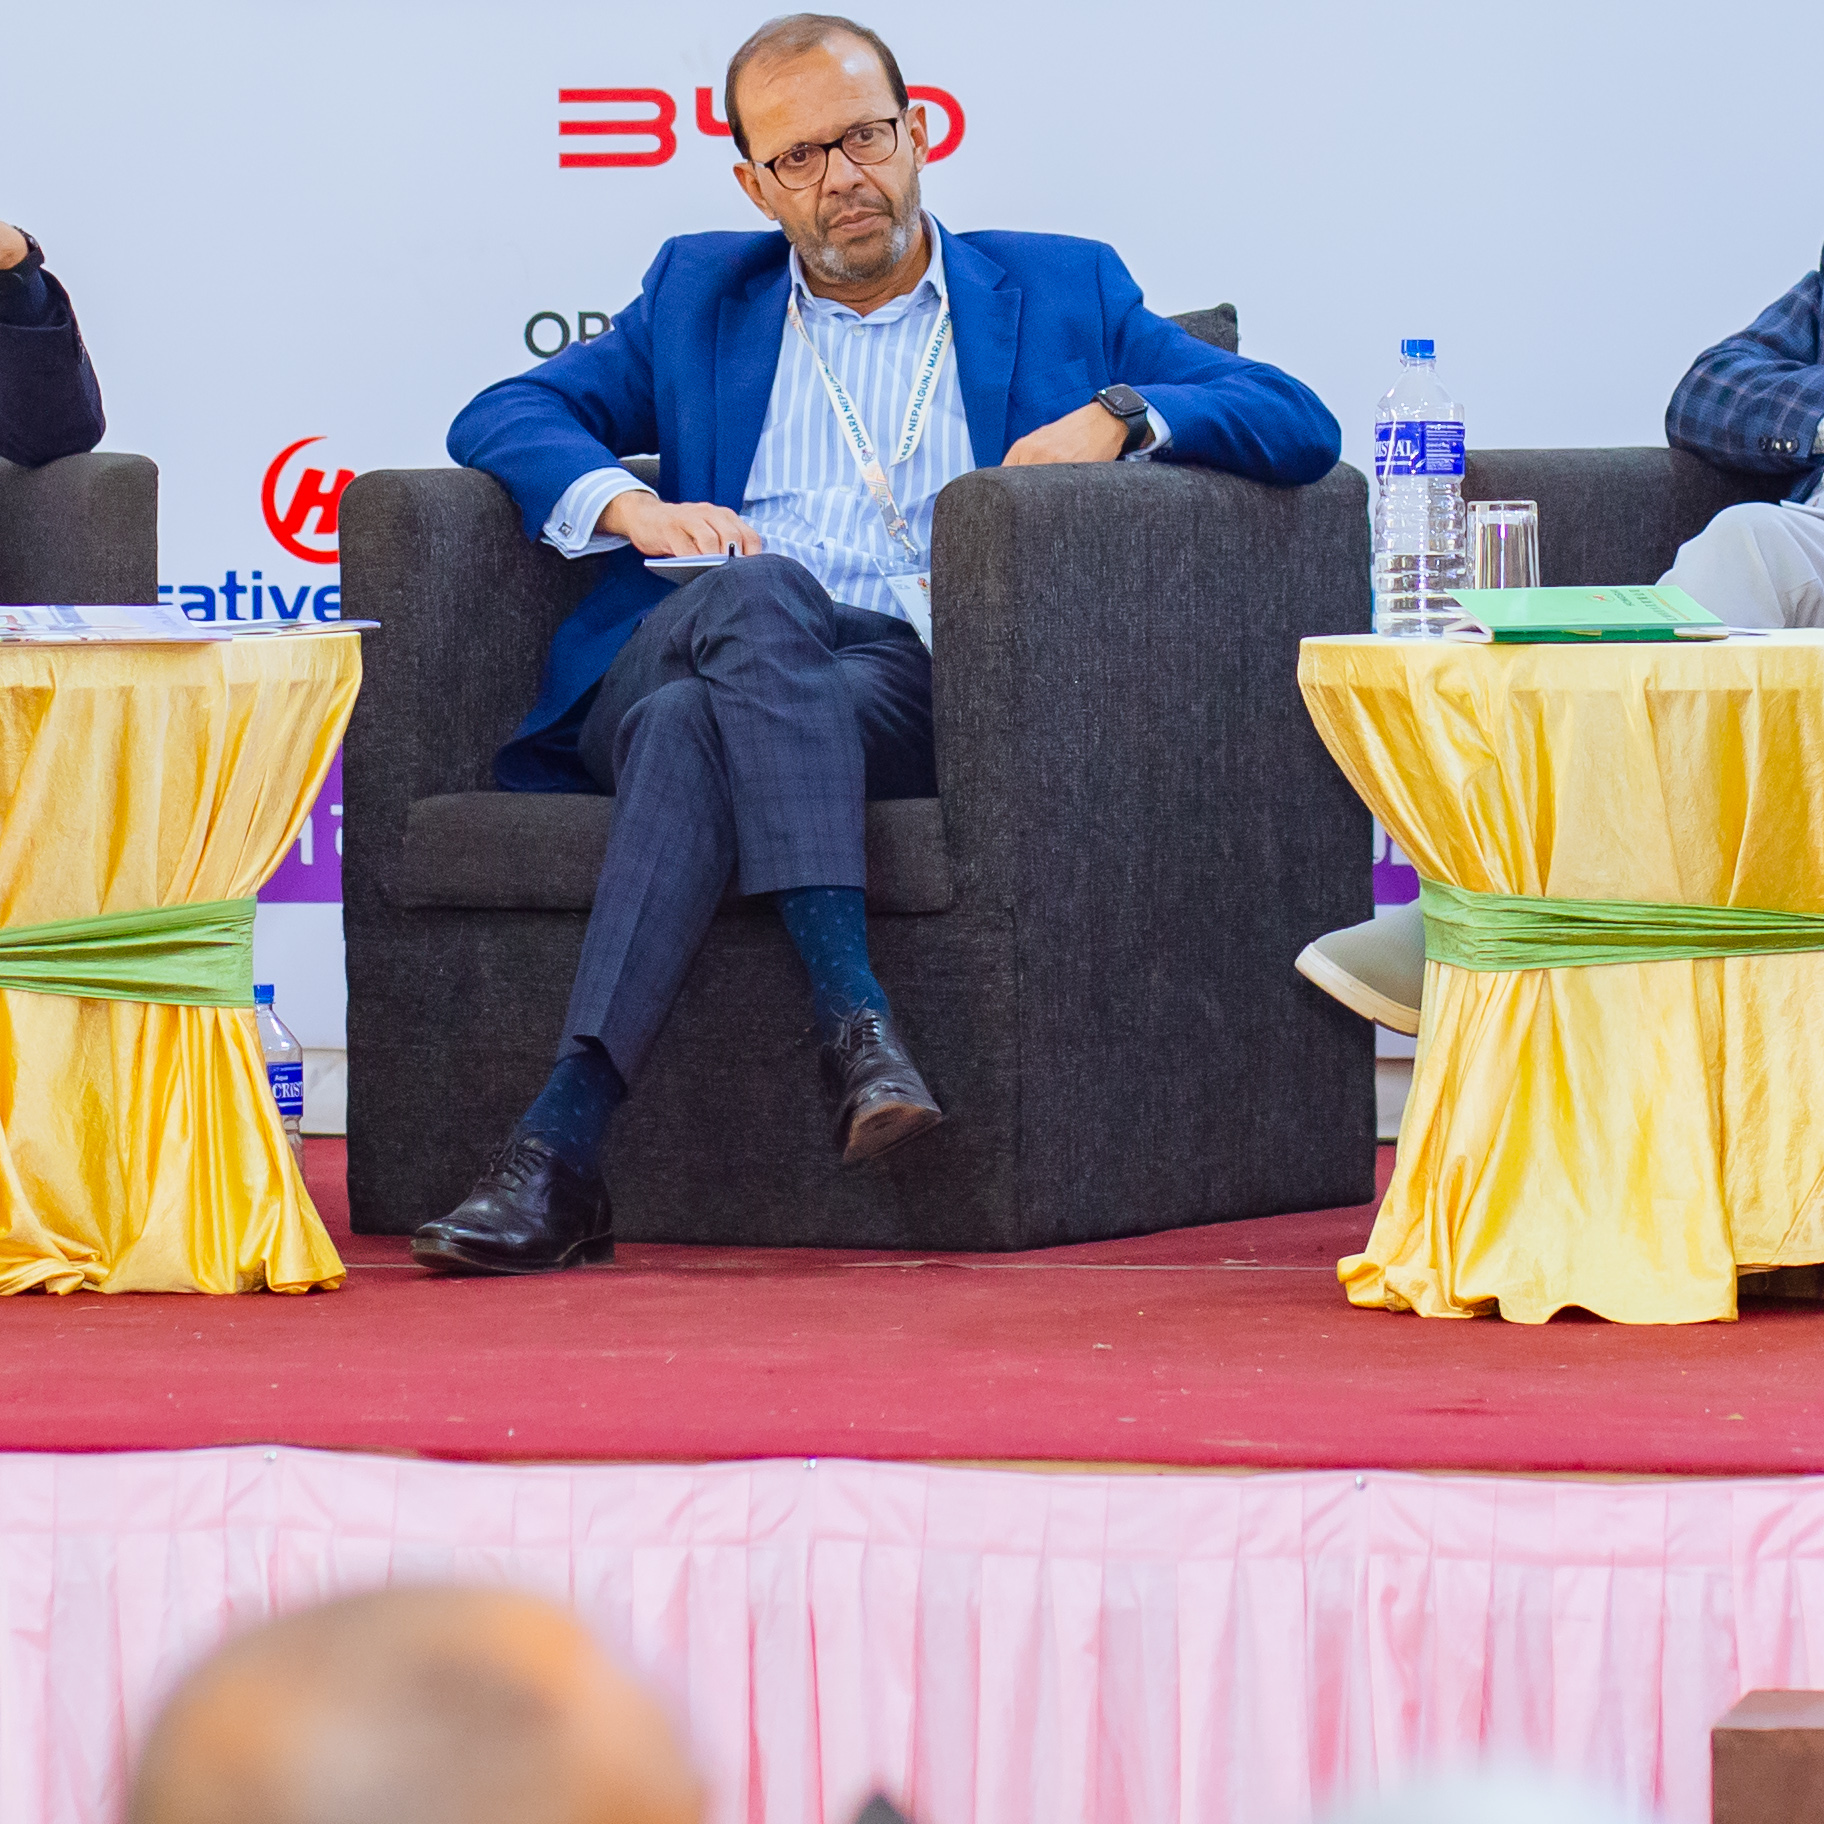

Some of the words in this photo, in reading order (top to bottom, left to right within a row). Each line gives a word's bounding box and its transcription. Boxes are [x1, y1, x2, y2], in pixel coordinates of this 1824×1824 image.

[908, 368, 934, 435] NEPALGUNJ
[927, 310, 951, 369] MARATHON
[847, 411, 867, 449] DHARA
